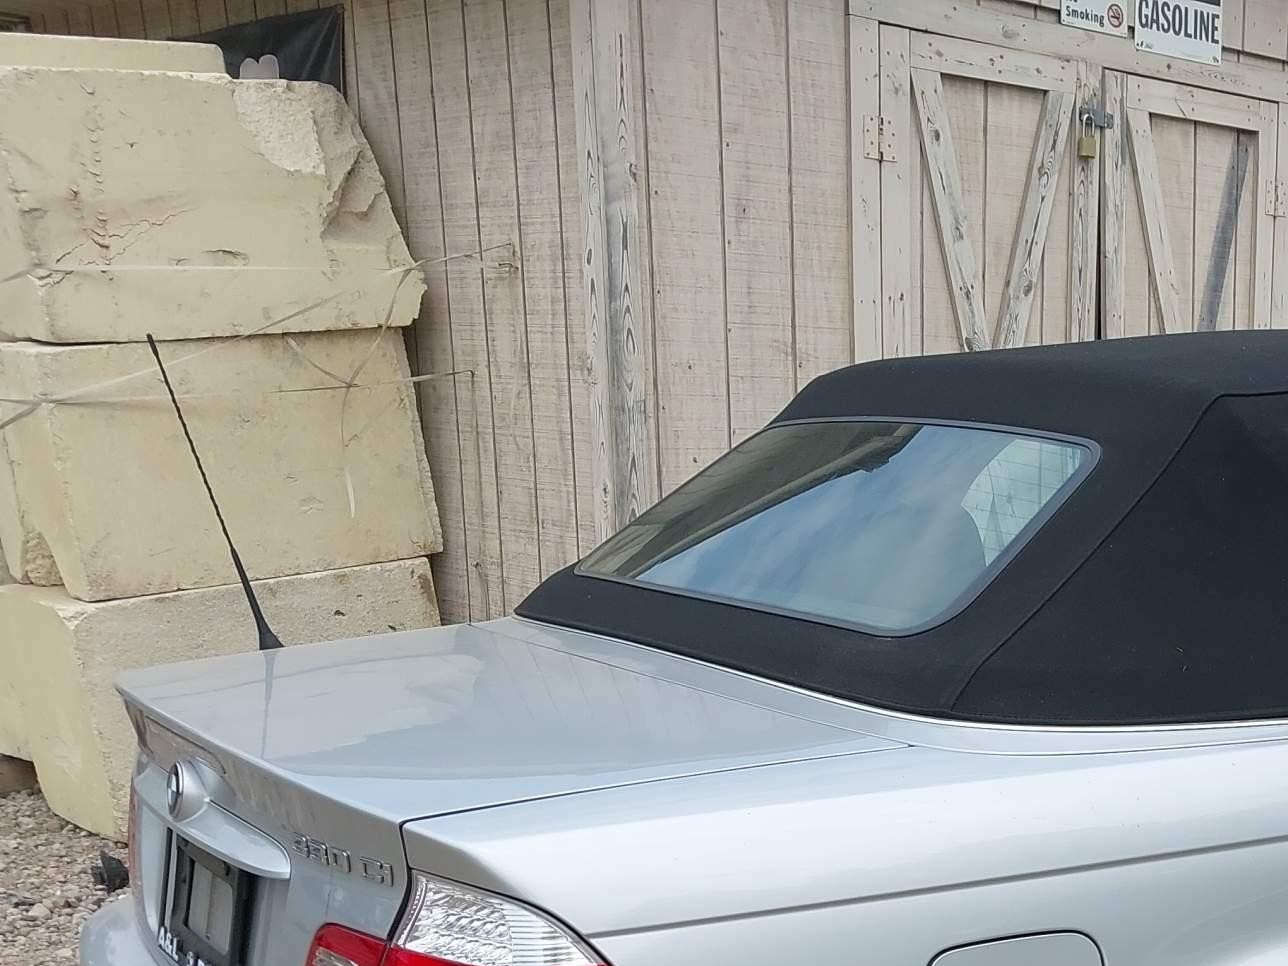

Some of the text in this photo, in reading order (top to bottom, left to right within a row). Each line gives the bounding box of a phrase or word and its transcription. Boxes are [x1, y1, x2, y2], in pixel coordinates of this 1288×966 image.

[1065, 5, 1105, 28] Smoking
[1138, 0, 1219, 44] GASOLINE
[159, 926, 178, 961] A&L
